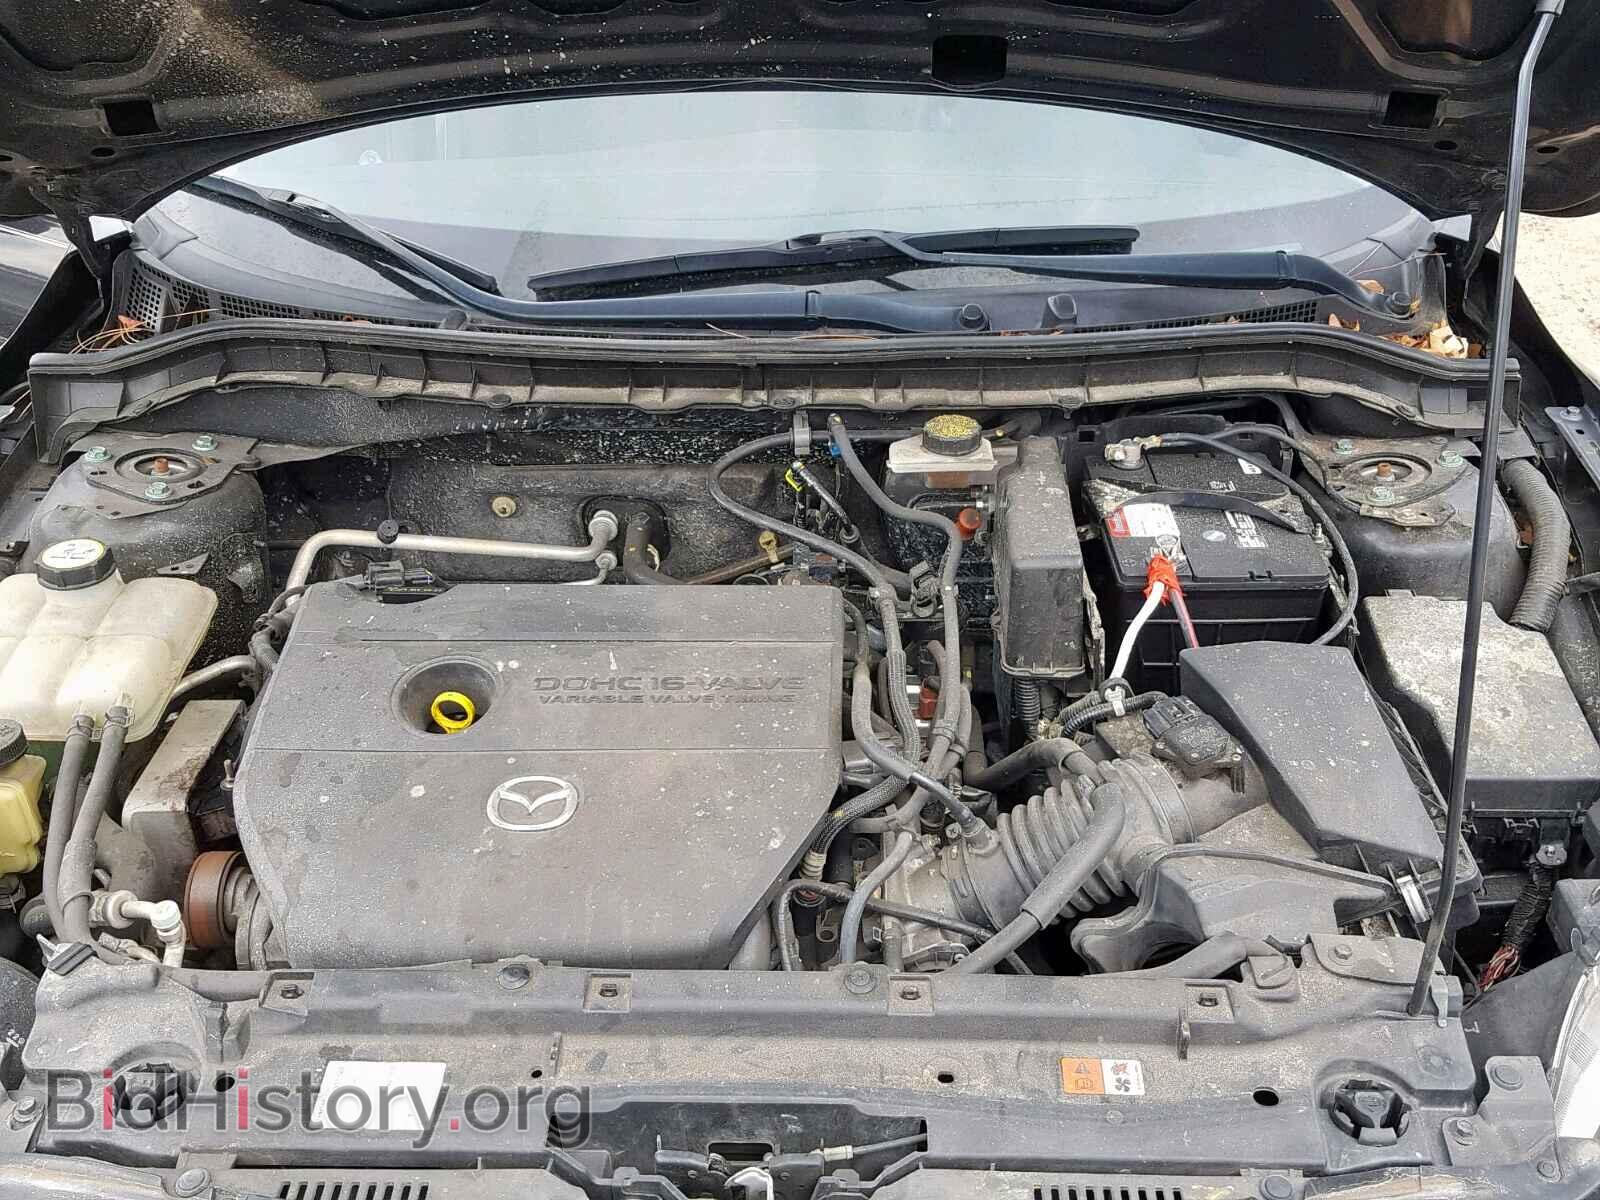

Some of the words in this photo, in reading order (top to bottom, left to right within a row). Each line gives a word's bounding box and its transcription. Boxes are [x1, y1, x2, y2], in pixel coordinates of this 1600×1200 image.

[532, 676, 642, 691] DOHC
[650, 676, 805, 691] 16-VALVE
[538, 694, 645, 704] VARIABLE
[649, 694, 714, 704] VALVE
